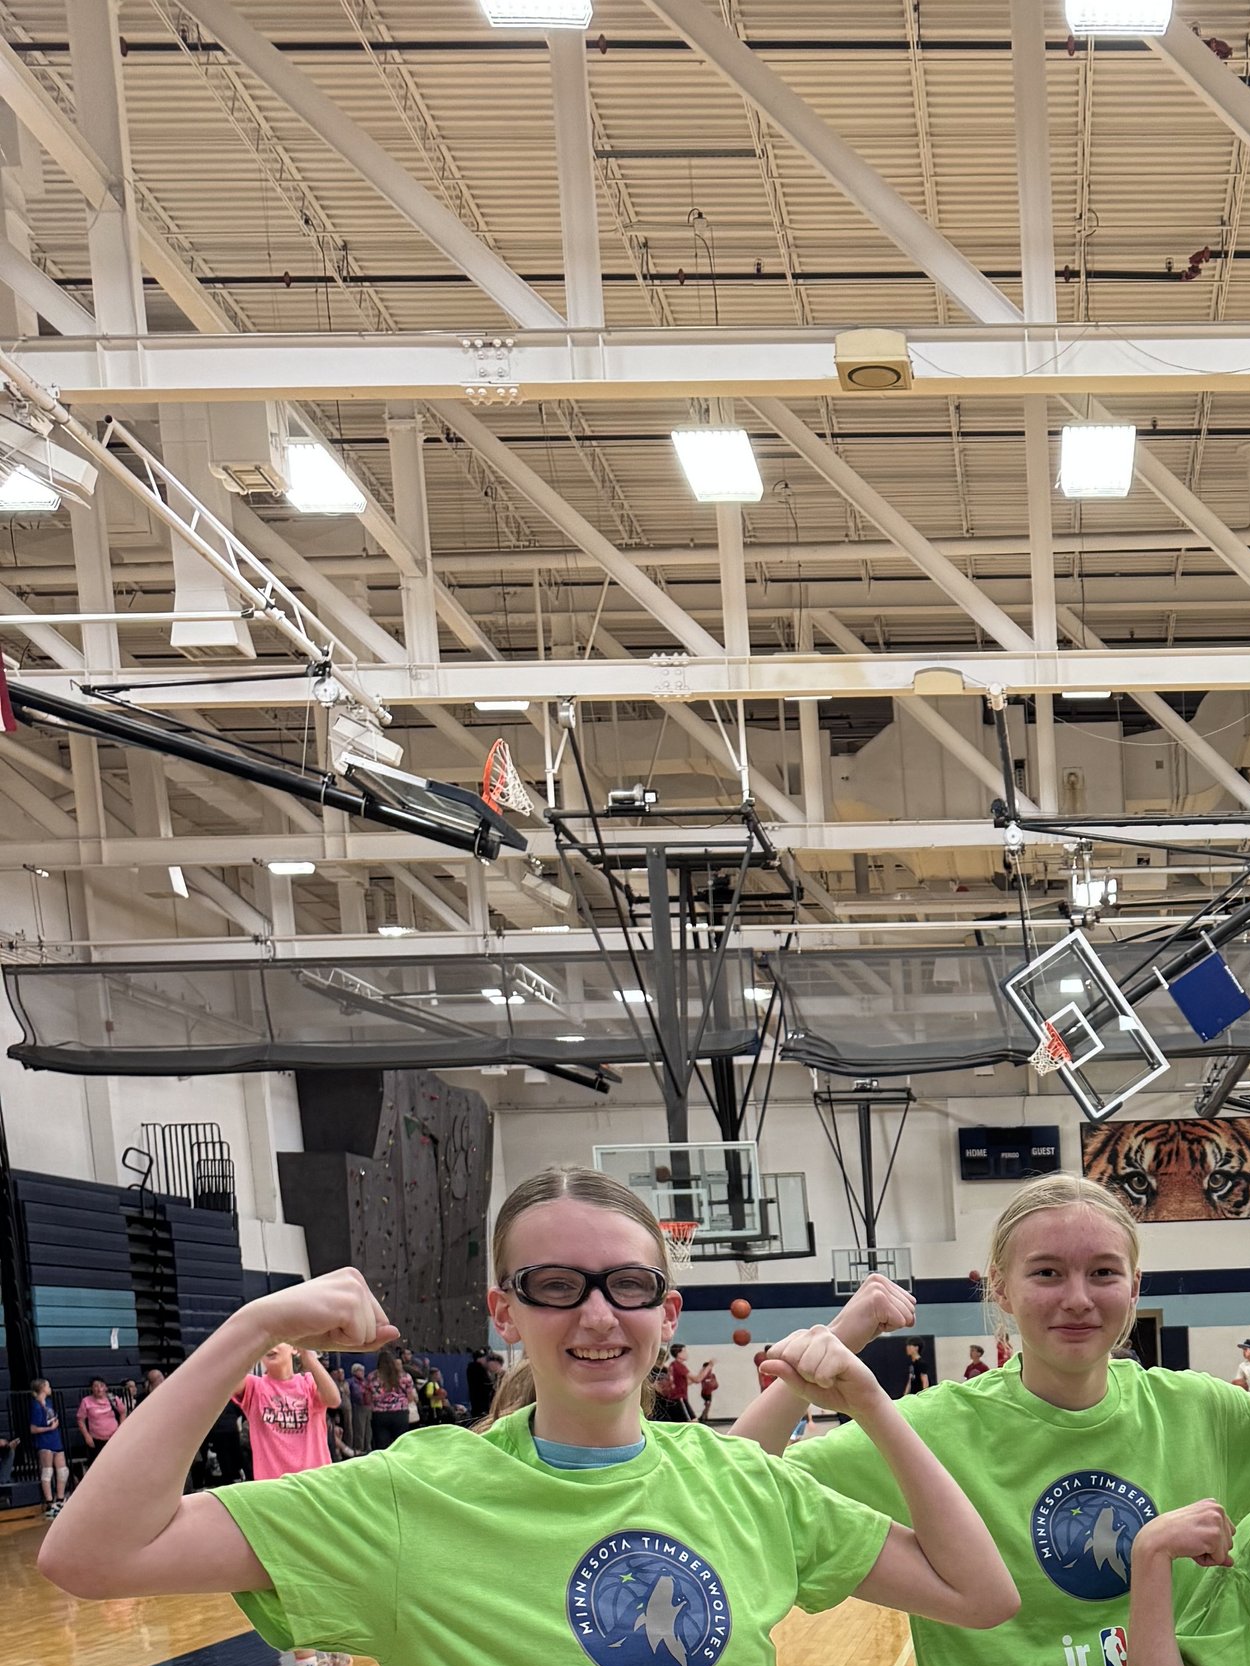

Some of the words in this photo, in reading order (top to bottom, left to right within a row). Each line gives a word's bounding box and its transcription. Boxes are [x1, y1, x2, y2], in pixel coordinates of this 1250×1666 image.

[966, 1148, 988, 1157] HOME
[1031, 1147, 1055, 1155] GUEST
[1036, 1477, 1081, 1560] MINNESOTA
[1090, 1475, 1155, 1518] TIMBERW
[574, 1538, 632, 1636] MINNESOTA
[641, 1536, 729, 1660] TIMBERWOLVES
